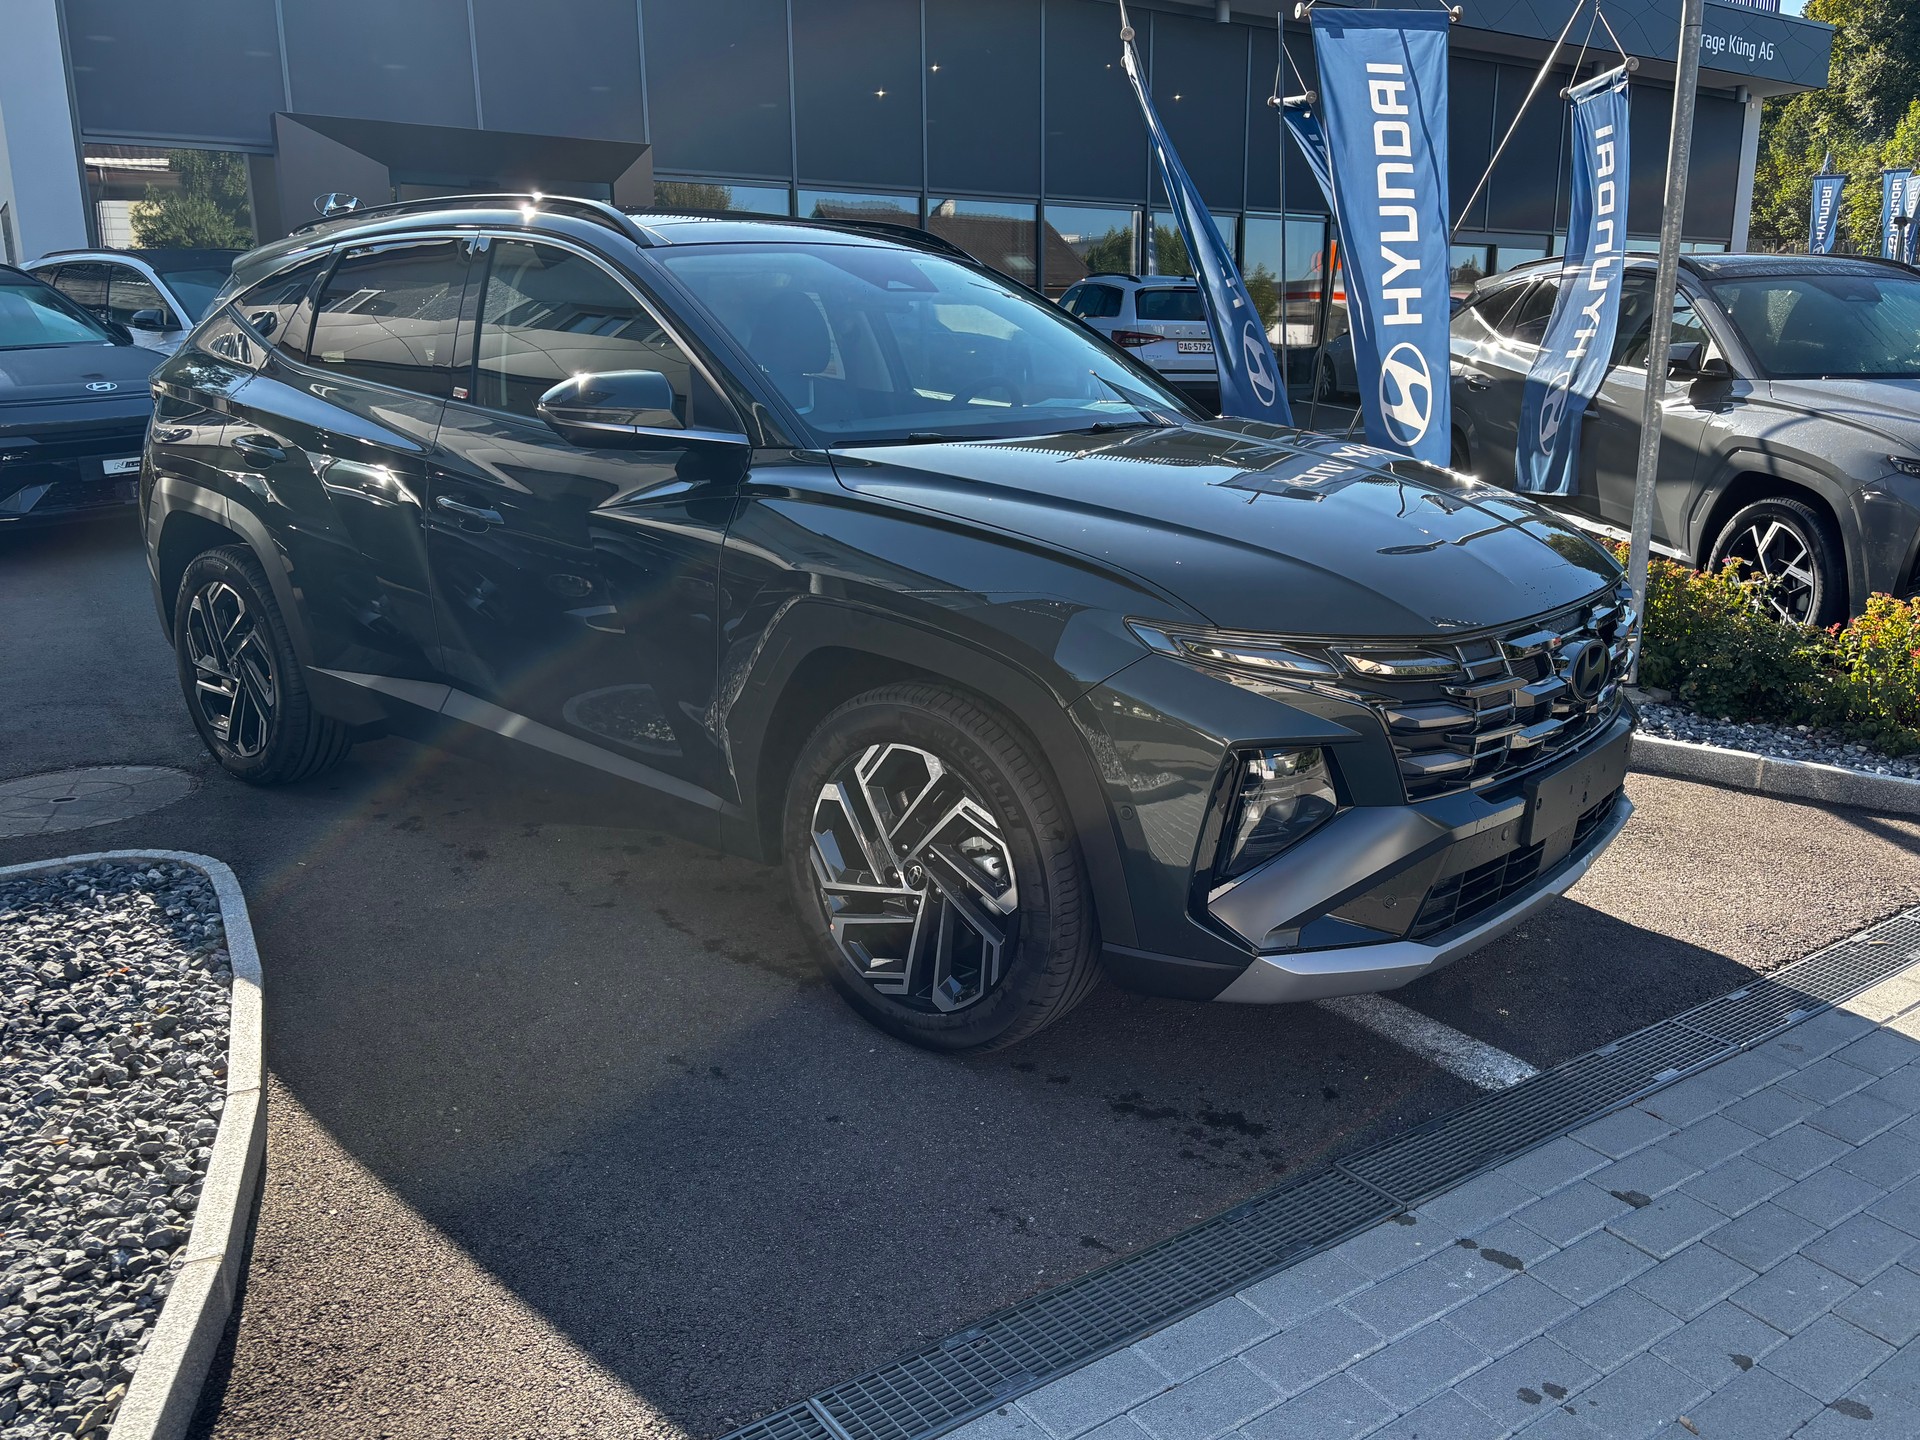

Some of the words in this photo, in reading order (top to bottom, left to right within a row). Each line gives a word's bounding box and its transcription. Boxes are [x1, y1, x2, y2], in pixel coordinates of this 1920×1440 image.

[1700, 33, 1726, 55] rage
[1728, 34, 1756, 62] Küng
[1758, 41, 1775, 61] AG
[1365, 62, 1423, 326] HYUNDAI
